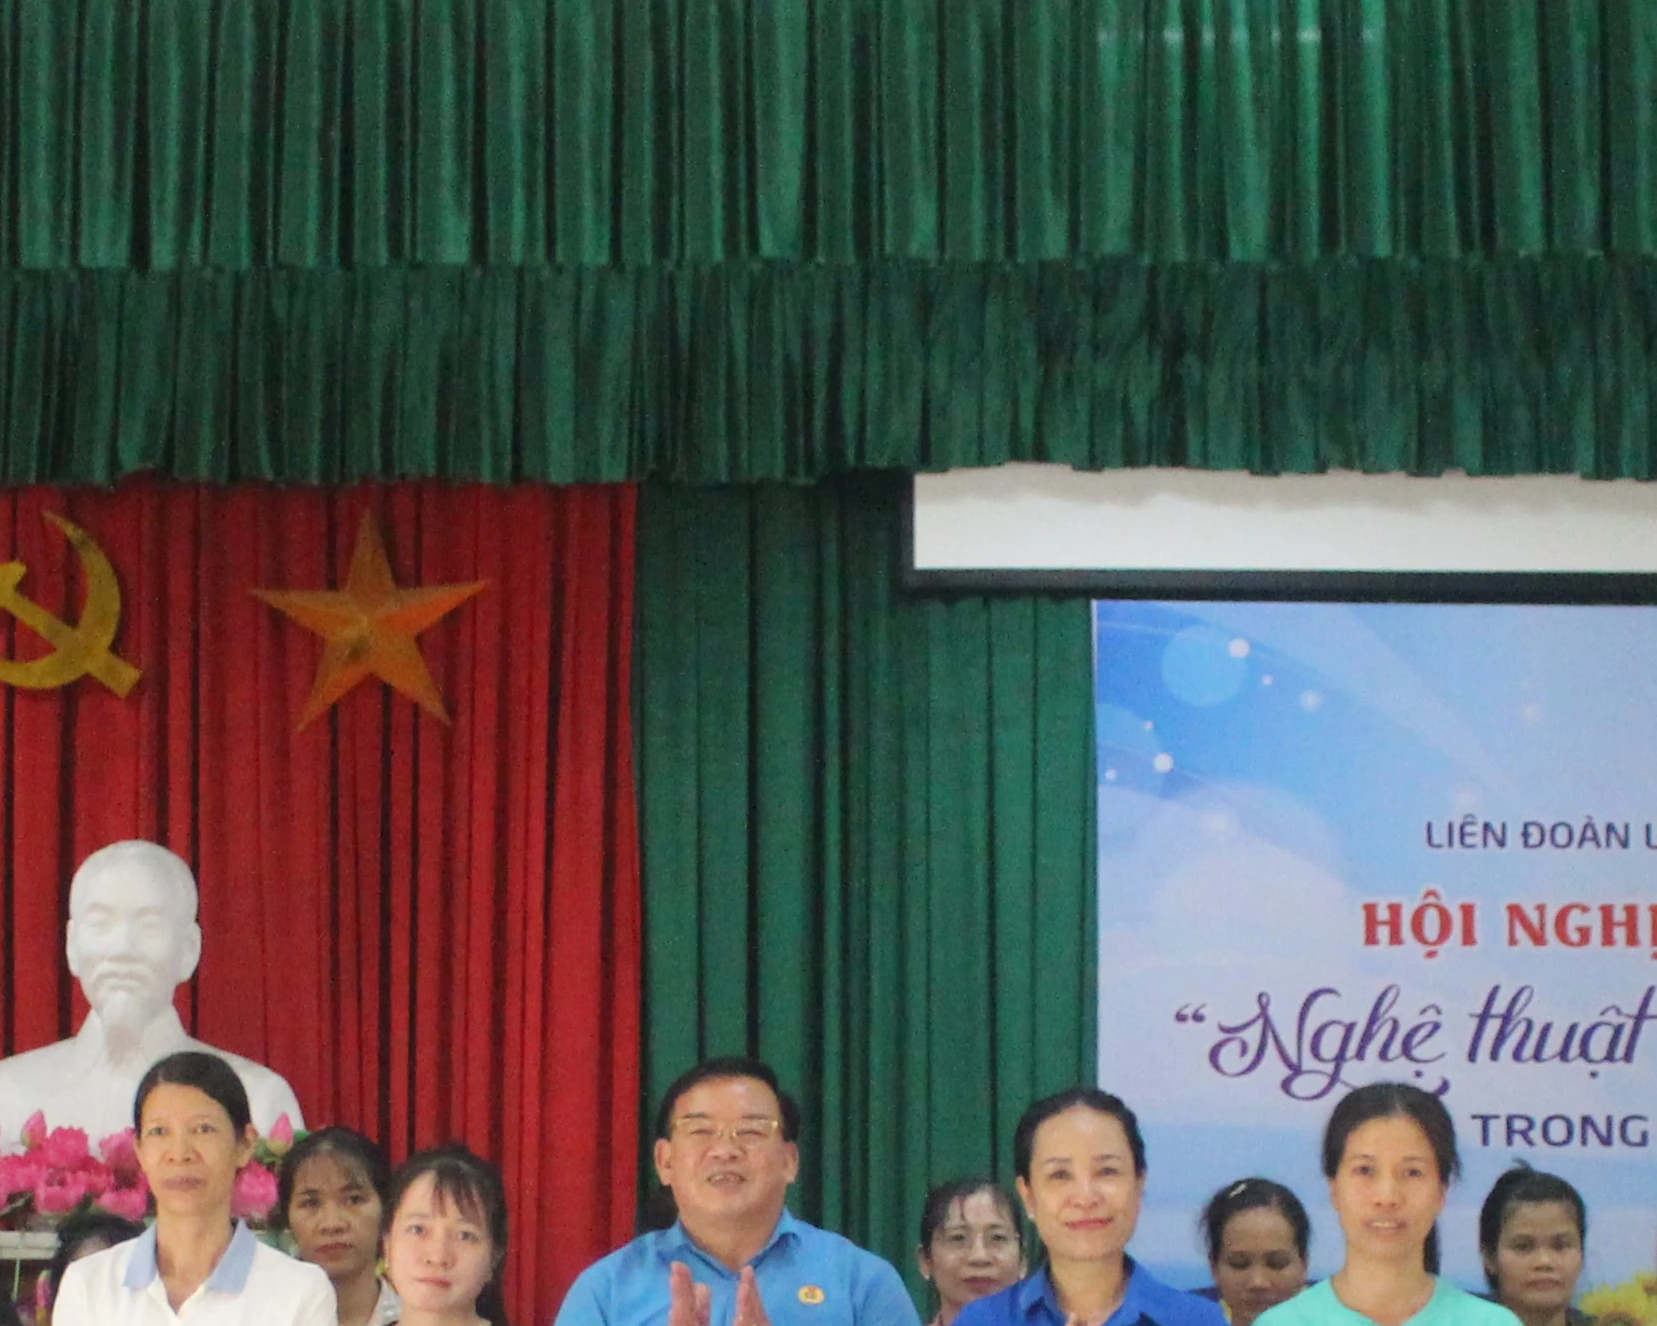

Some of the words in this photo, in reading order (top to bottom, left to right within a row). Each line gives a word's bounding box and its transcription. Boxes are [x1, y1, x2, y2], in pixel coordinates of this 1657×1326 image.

[1426, 813, 1507, 849] LIÊN
[1521, 814, 1630, 850] ĐOÀN
[1361, 889, 1477, 960] HỘI
[1471, 1113, 1650, 1149] TRONG
